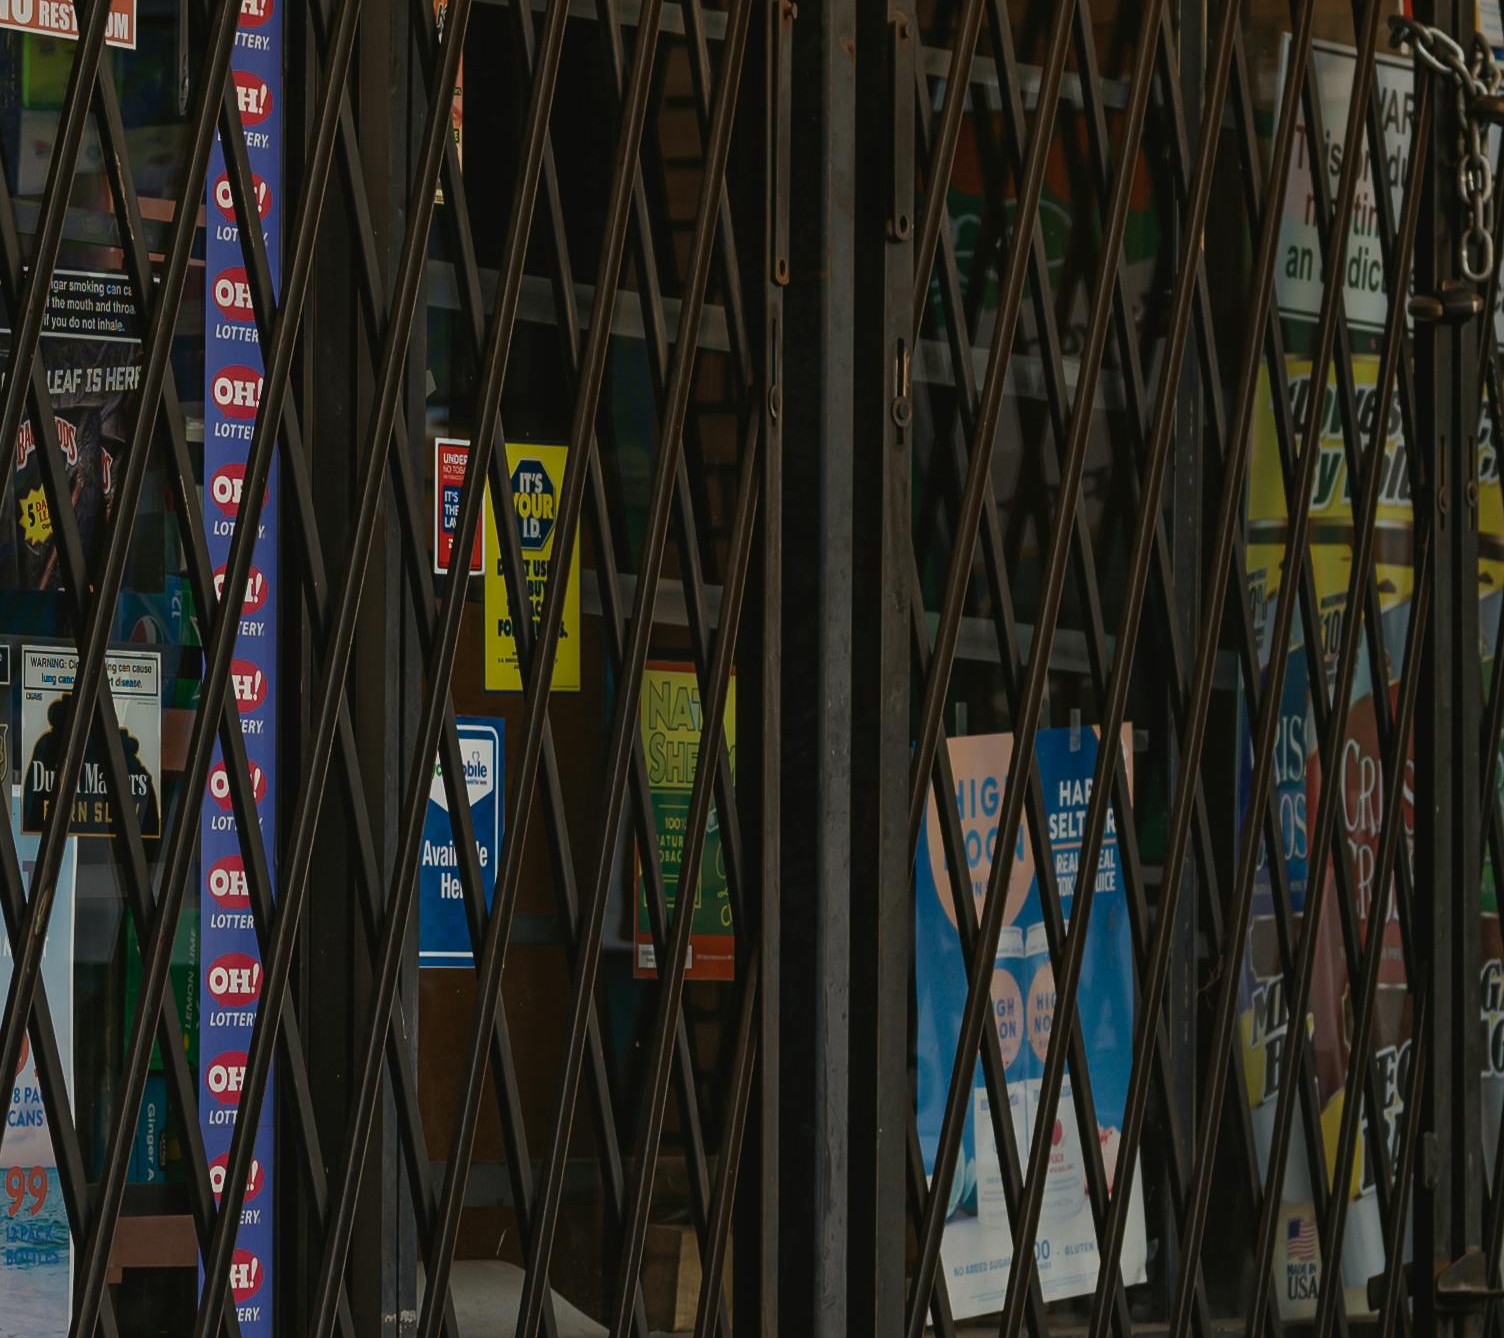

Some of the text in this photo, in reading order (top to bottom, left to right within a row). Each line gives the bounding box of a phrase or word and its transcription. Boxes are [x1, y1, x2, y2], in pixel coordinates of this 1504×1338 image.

[38, 0, 129, 40] RESTOM
[1285, 244, 1313, 282] an
[68, 280, 122, 296] smoking can
[52, 297, 112, 313] the mouth and
[51, 316, 126, 333] you do not inhale.
[215, 323, 259, 343] LOTTER
[47, 368, 112, 394] LEAF IS
[213, 378, 263, 407] OH!
[518, 471, 543, 494] IT'S
[444, 490, 459, 503] IT'S
[27, 502, 37, 528] 5
[513, 493, 553, 520] YOUR
[522, 518, 542, 539] I.D.
[30, 656, 67, 670] WARNING:
[117, 664, 152, 674] can cause
[41, 672, 57, 685] lung
[210, 912, 254, 930] LOTTER
[207, 962, 261, 996] OH!
[208, 1012, 255, 1028] LOTTER
[7, 1109, 44, 1128] CANS
[1064, 1240, 1095, 1256] GLUTEN
[1286, 1262, 1317, 1278] MADE IN
[1286, 1275, 1321, 1302] USA
